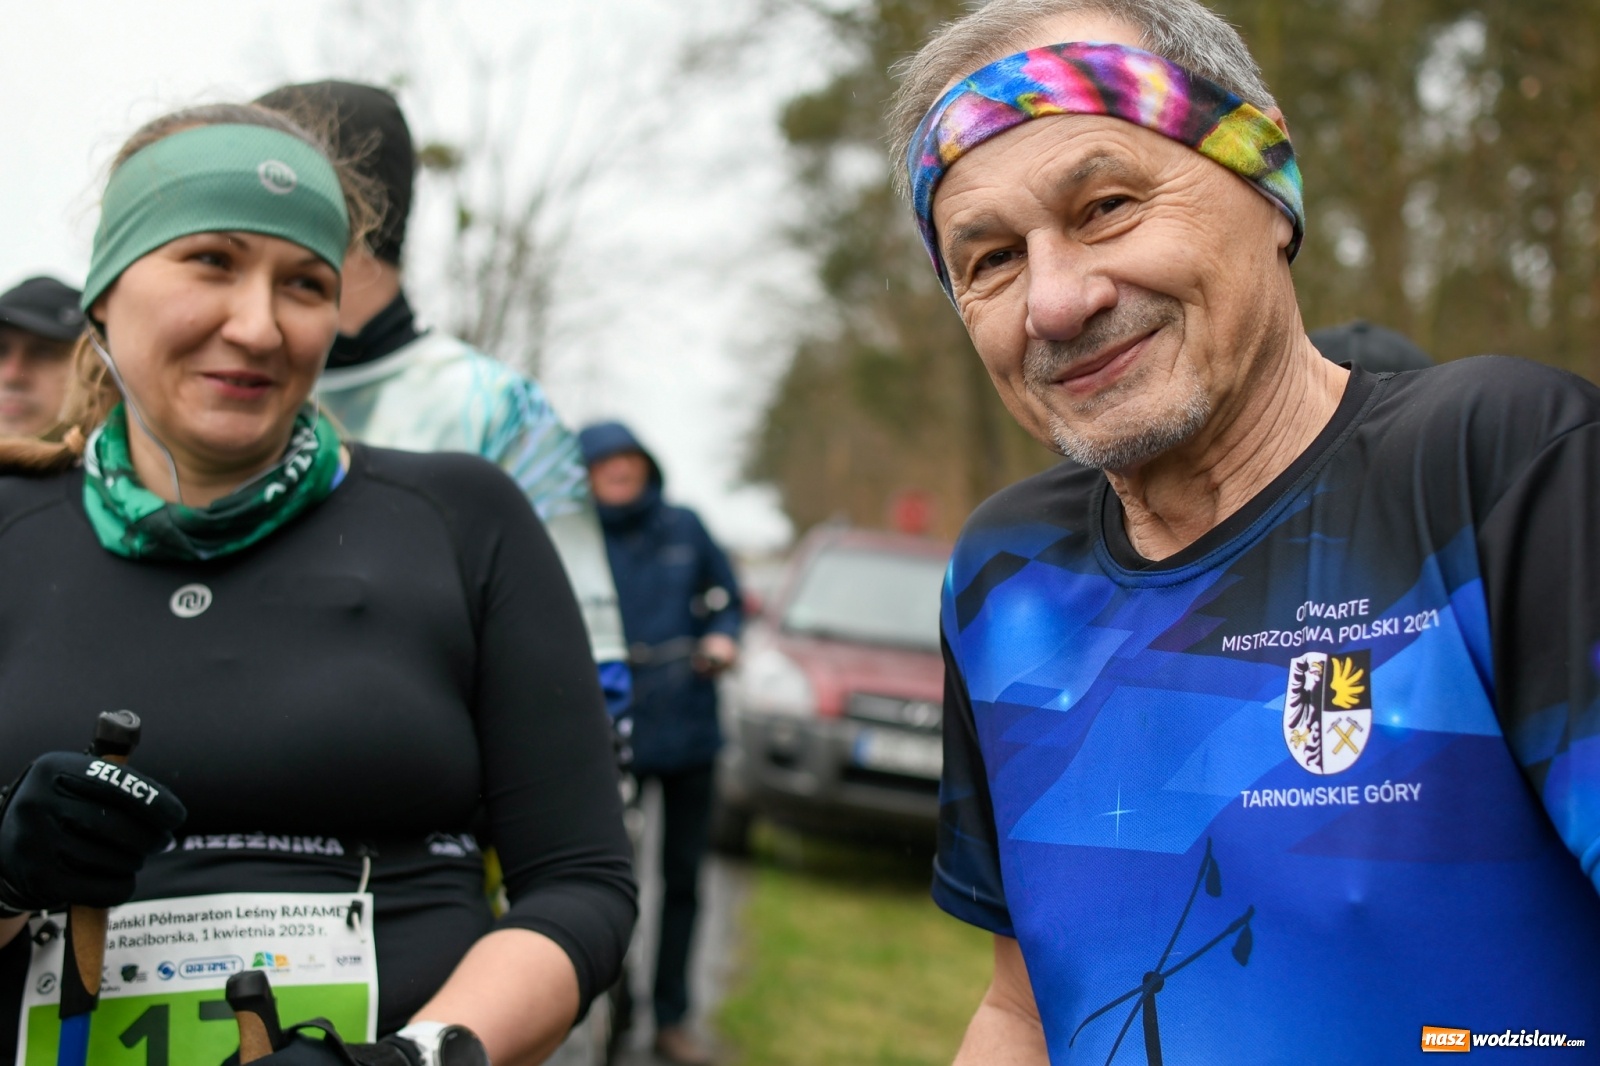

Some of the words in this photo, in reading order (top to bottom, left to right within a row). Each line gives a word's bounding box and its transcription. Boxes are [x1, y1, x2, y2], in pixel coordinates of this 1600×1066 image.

[1296, 599, 1370, 622] OTWARTE
[1221, 625, 1335, 652] MISTRZOSTWA
[1338, 617, 1400, 644] POLSKI
[1403, 609, 1440, 634] 2021
[85, 760, 160, 806] SELECT
[1240, 786, 1361, 809] TARNOWSKIE
[1363, 779, 1422, 804] GÓRY
[106, 914, 146, 931] iański
[149, 907, 233, 927] Półmaraton
[236, 905, 278, 920] Leśny
[118, 930, 199, 949] Raciborska,
[202, 928, 209, 941] 1
[213, 925, 276, 939] kwietnia
[279, 923, 316, 938] 2023
[119, 1000, 236, 1066] 1
